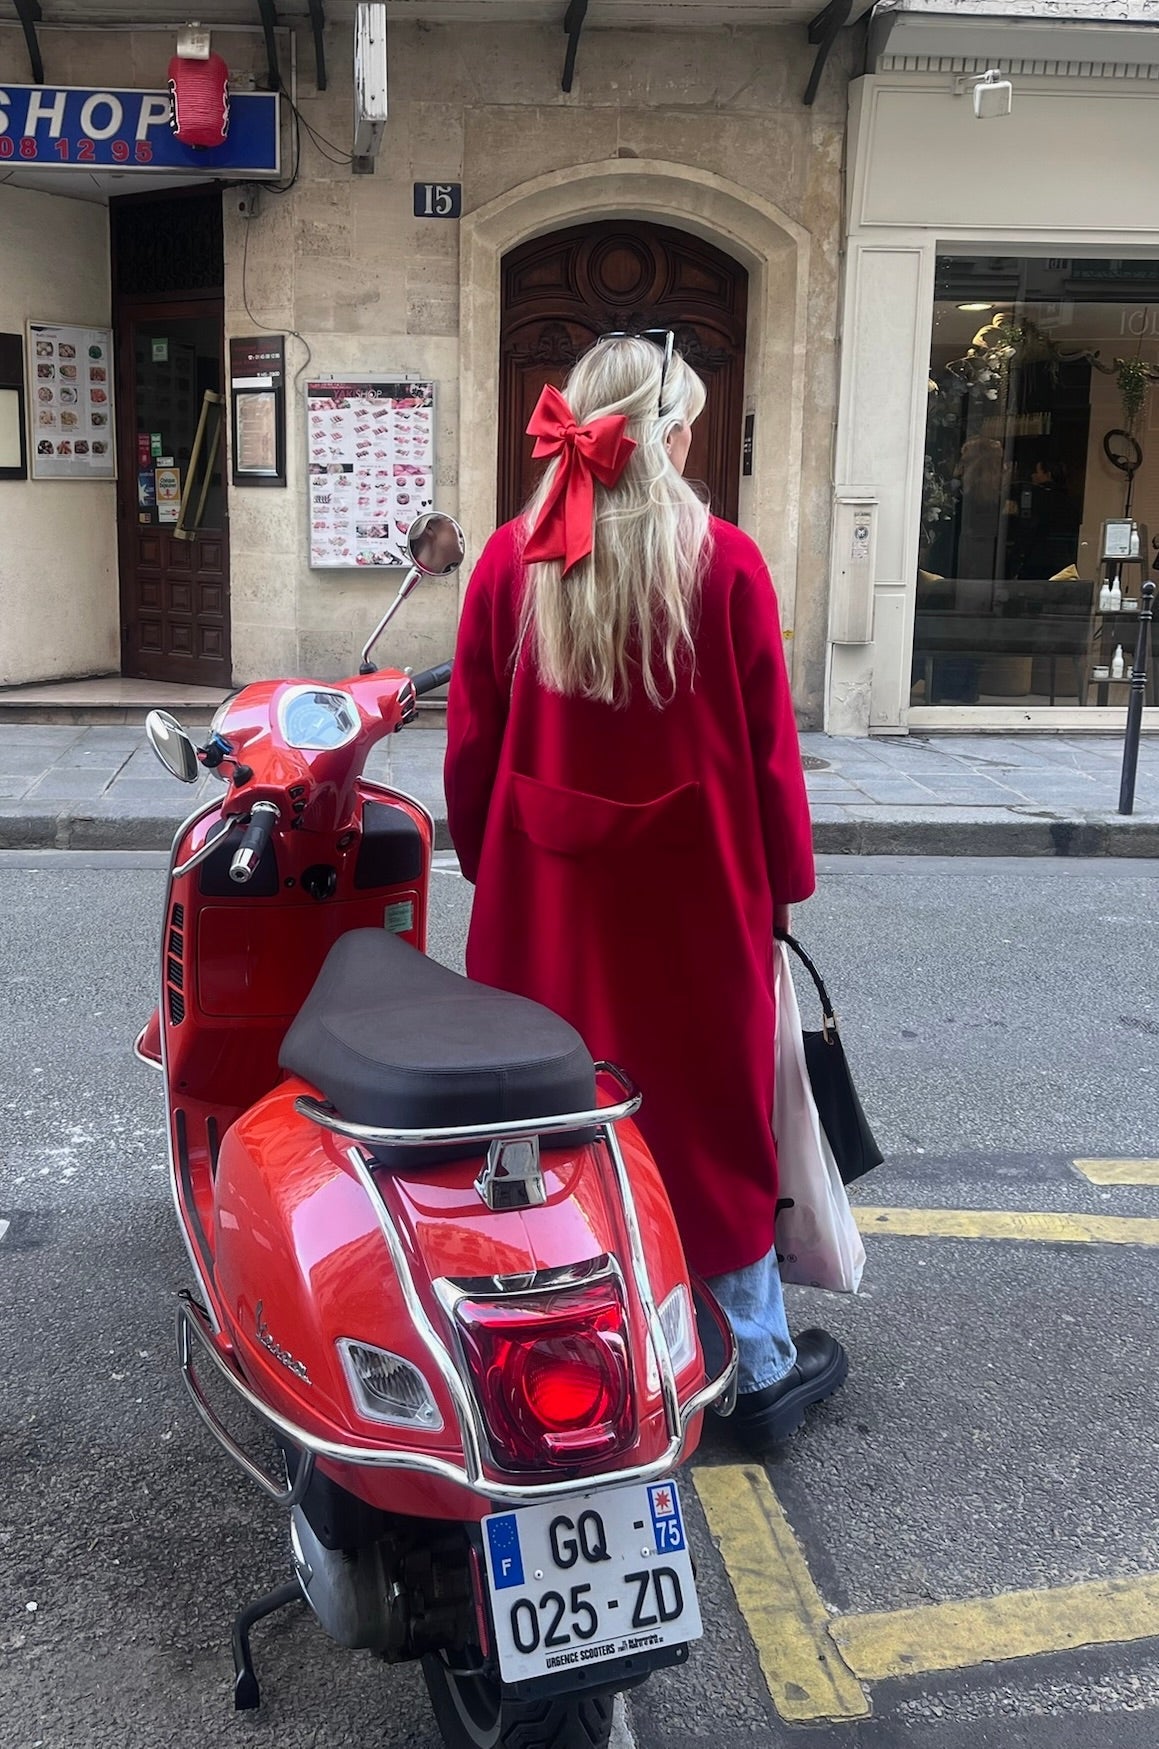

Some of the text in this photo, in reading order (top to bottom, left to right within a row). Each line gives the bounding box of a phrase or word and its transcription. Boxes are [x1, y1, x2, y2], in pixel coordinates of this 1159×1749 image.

[55, 138, 96, 160] 12
[111, 140, 153, 162] 95
[424, 185, 453, 214] 15
[549, 1509, 612, 1569] GQ
[655, 1519, 681, 1548] 75
[501, 1558, 512, 1577] F
[510, 1566, 684, 1654] 025-ZD
[546, 1643, 616, 1669] URGENCE SCOOTERS
